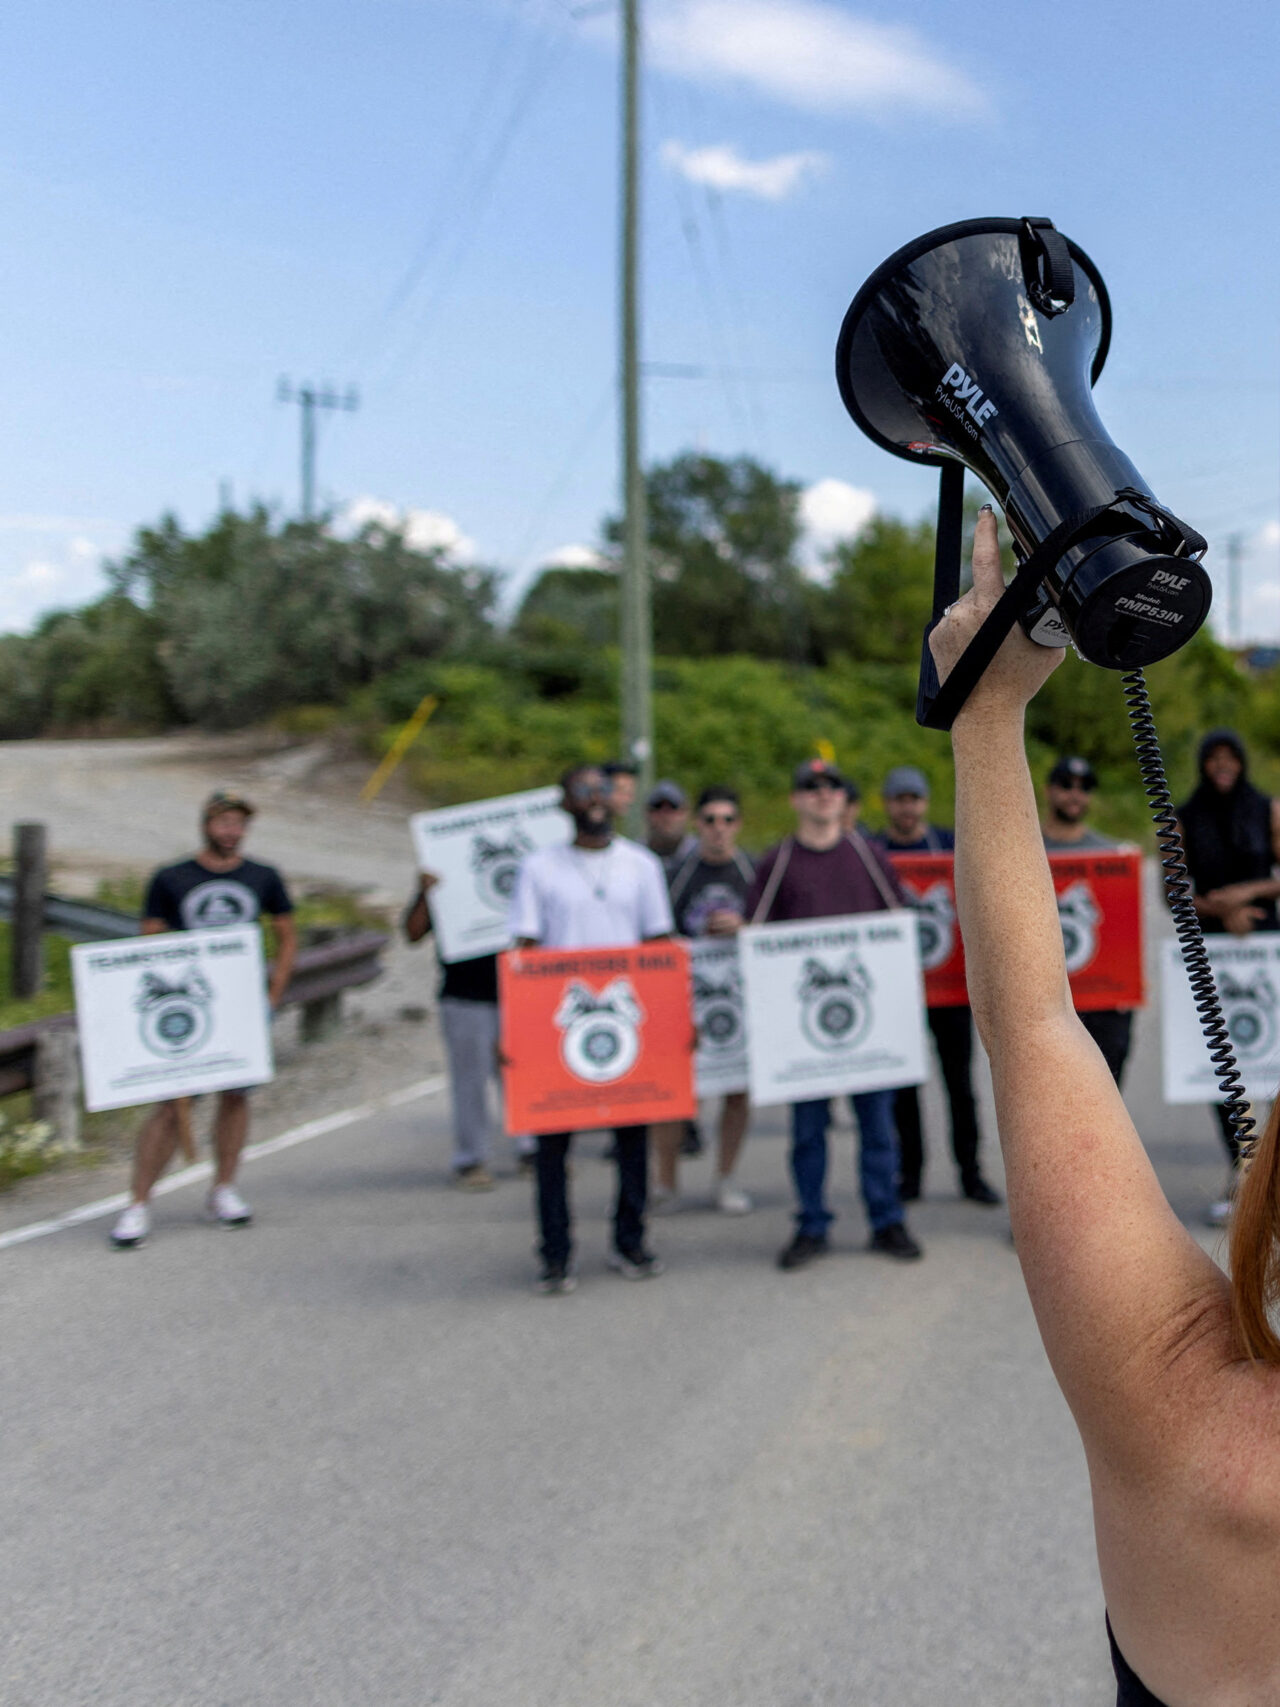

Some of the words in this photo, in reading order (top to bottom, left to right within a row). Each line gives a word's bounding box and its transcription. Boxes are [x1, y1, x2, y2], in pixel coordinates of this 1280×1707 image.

[935, 385, 979, 441] PyleUSA.com
[1114, 596, 1184, 624] PMP53IN
[1135, 593, 1161, 605] Model:
